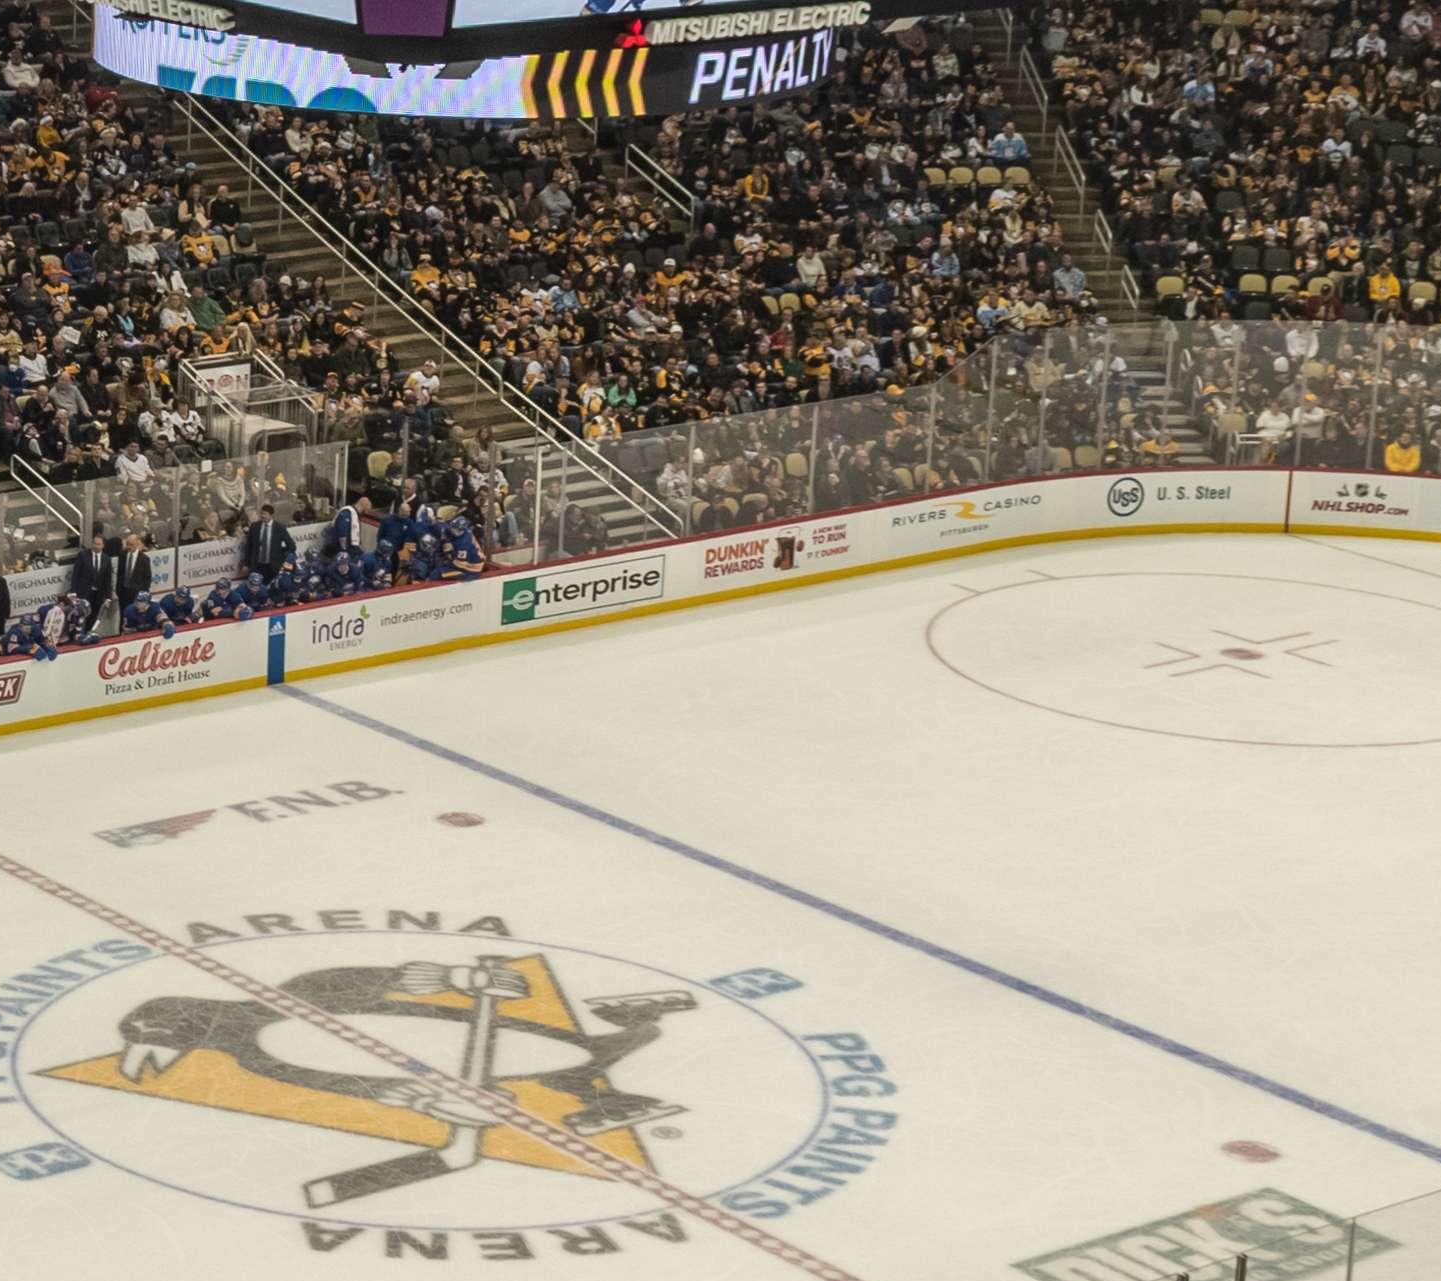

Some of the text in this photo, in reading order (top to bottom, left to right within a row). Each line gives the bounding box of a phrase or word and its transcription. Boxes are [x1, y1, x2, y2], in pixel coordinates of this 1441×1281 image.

[646, 1, 871, 45] MITSUBISHI ELECTRIC
[688, 27, 834, 105] PENALTY
[892, 495, 1042, 528] RIVERS CASINO
[1112, 486, 1140, 508] USS
[1195, 485, 1231, 500] Steel
[704, 557, 765, 580] REWARDS
[512, 569, 661, 611] enterprise
[312, 615, 365, 645] indra
[379, 601, 473, 628] indraenergy.com
[98, 636, 216, 681] Caliente
[329, 638, 363, 652] ENERGY
[104, 669, 211, 696] Pizza & Draft House
[224, 781, 404, 824] F.N.B.
[186, 909, 516, 949] ARENA
[799, 1031, 897, 1097] PPG
[718, 1105, 898, 1219] PAINTS
[299, 1212, 690, 1260] ARENA
